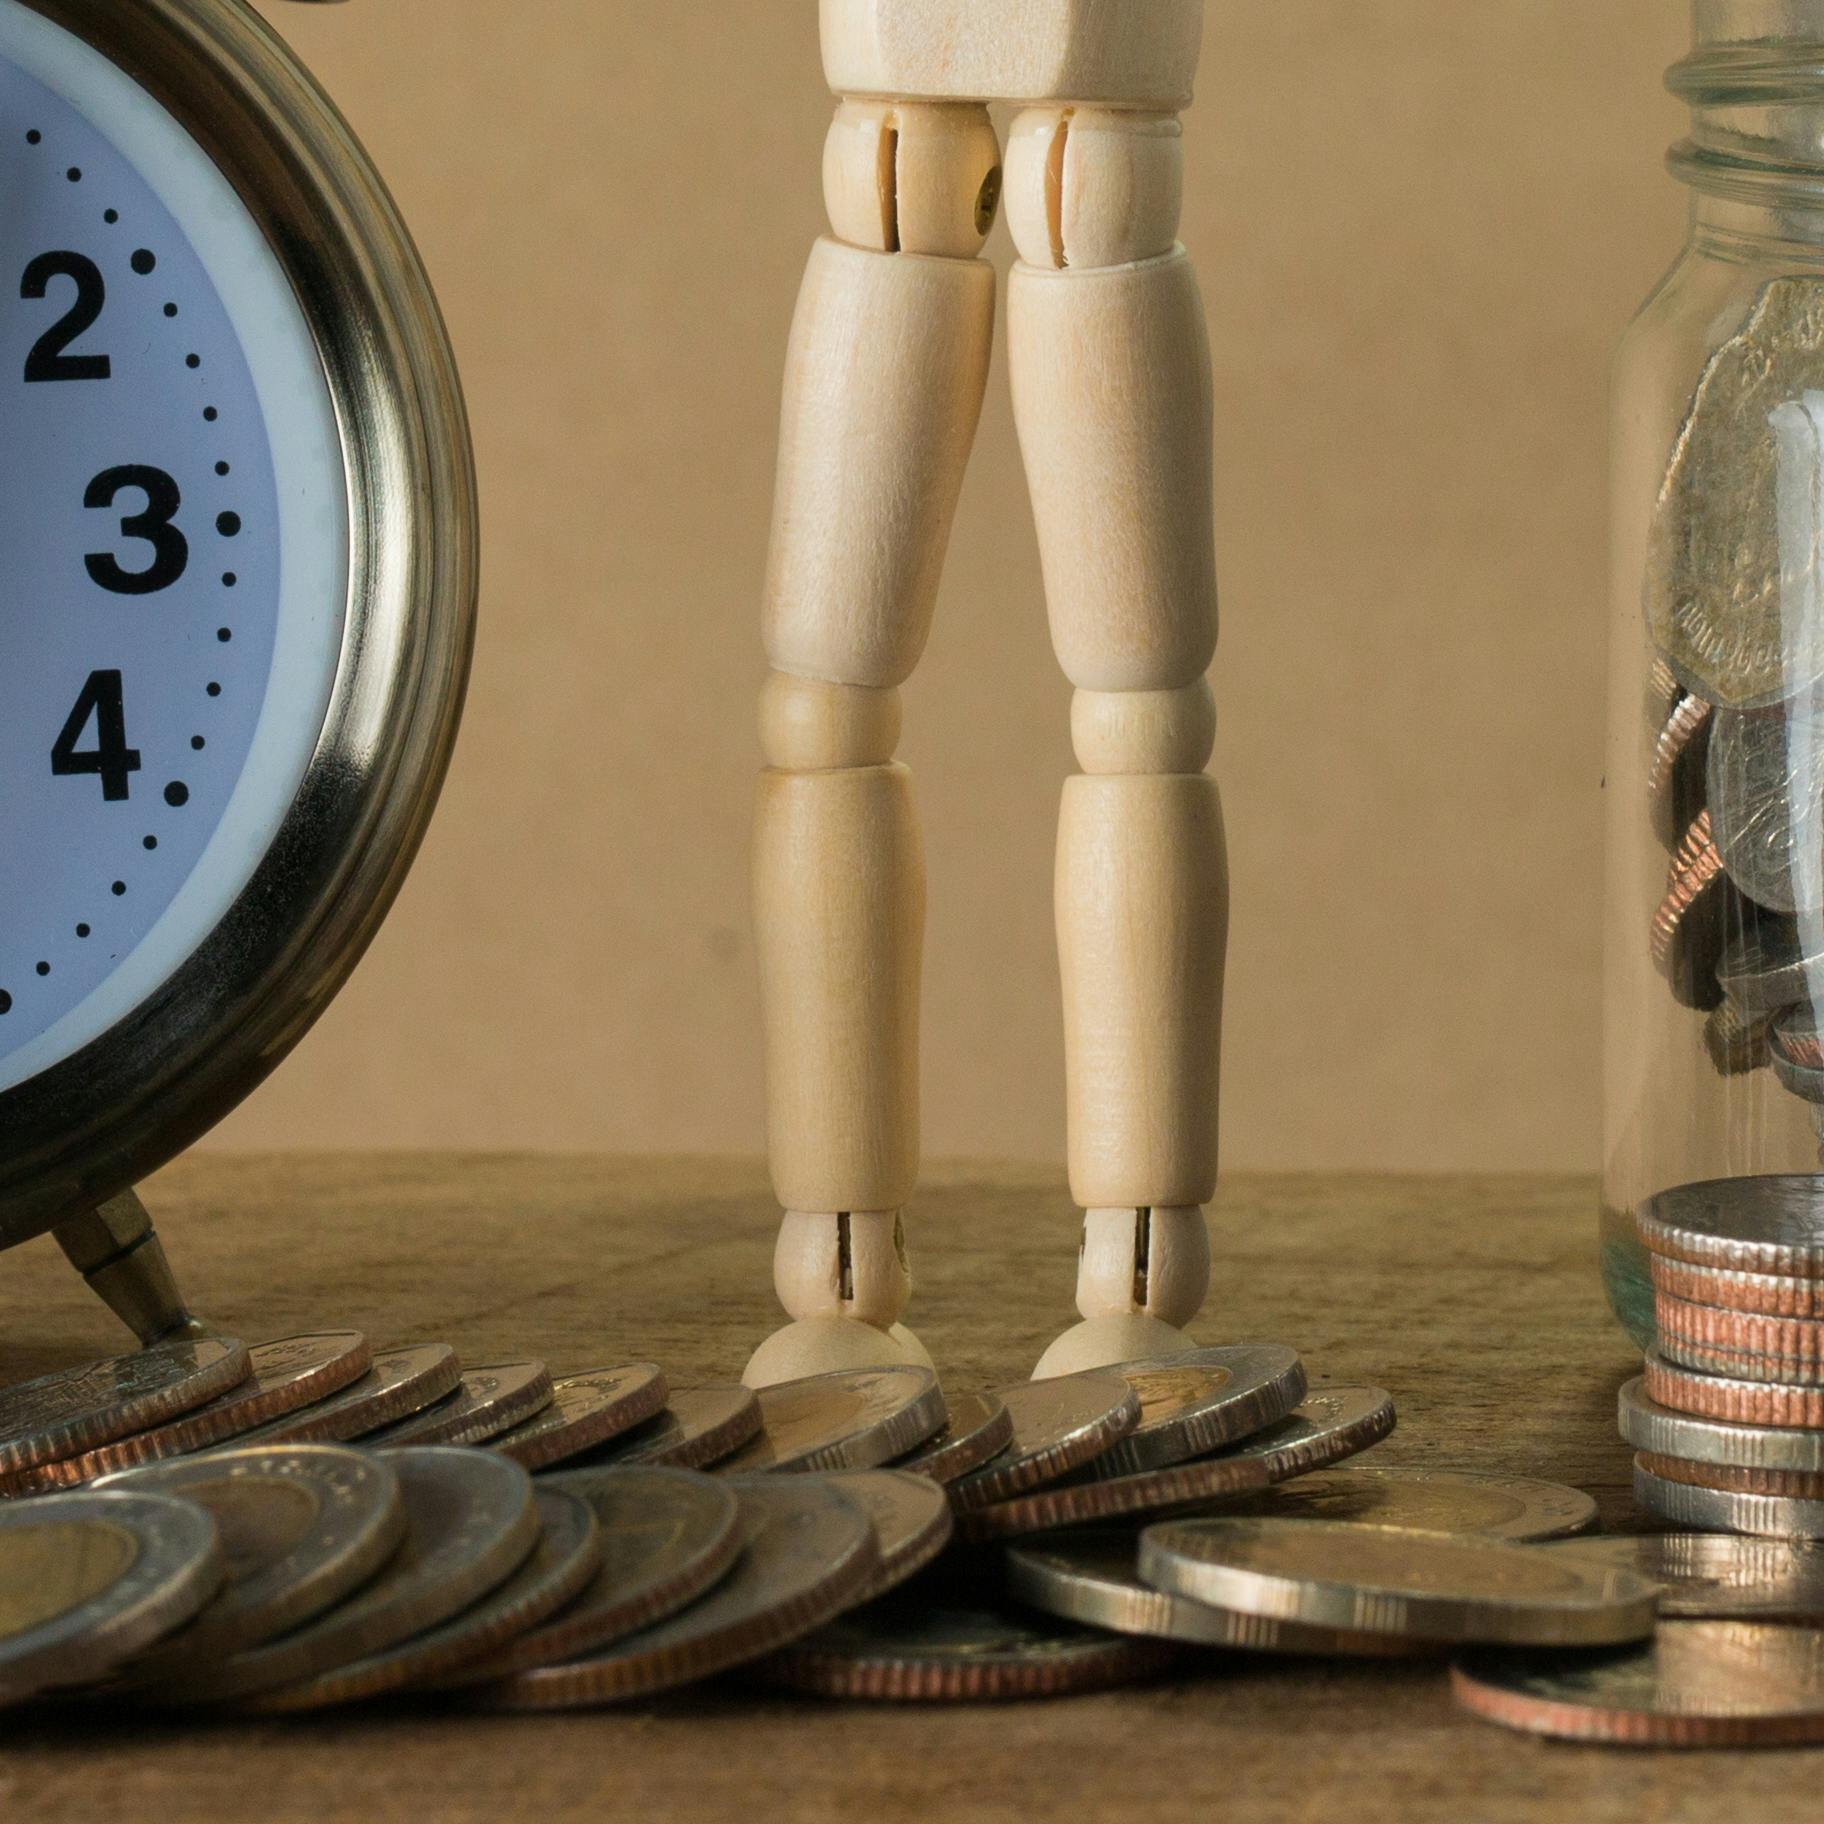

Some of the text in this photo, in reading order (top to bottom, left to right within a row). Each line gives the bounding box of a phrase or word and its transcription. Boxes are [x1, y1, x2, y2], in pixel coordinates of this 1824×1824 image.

[19, 251, 111, 383] 2
[83, 464, 188, 594] 3
[50, 670, 142, 801] 4
